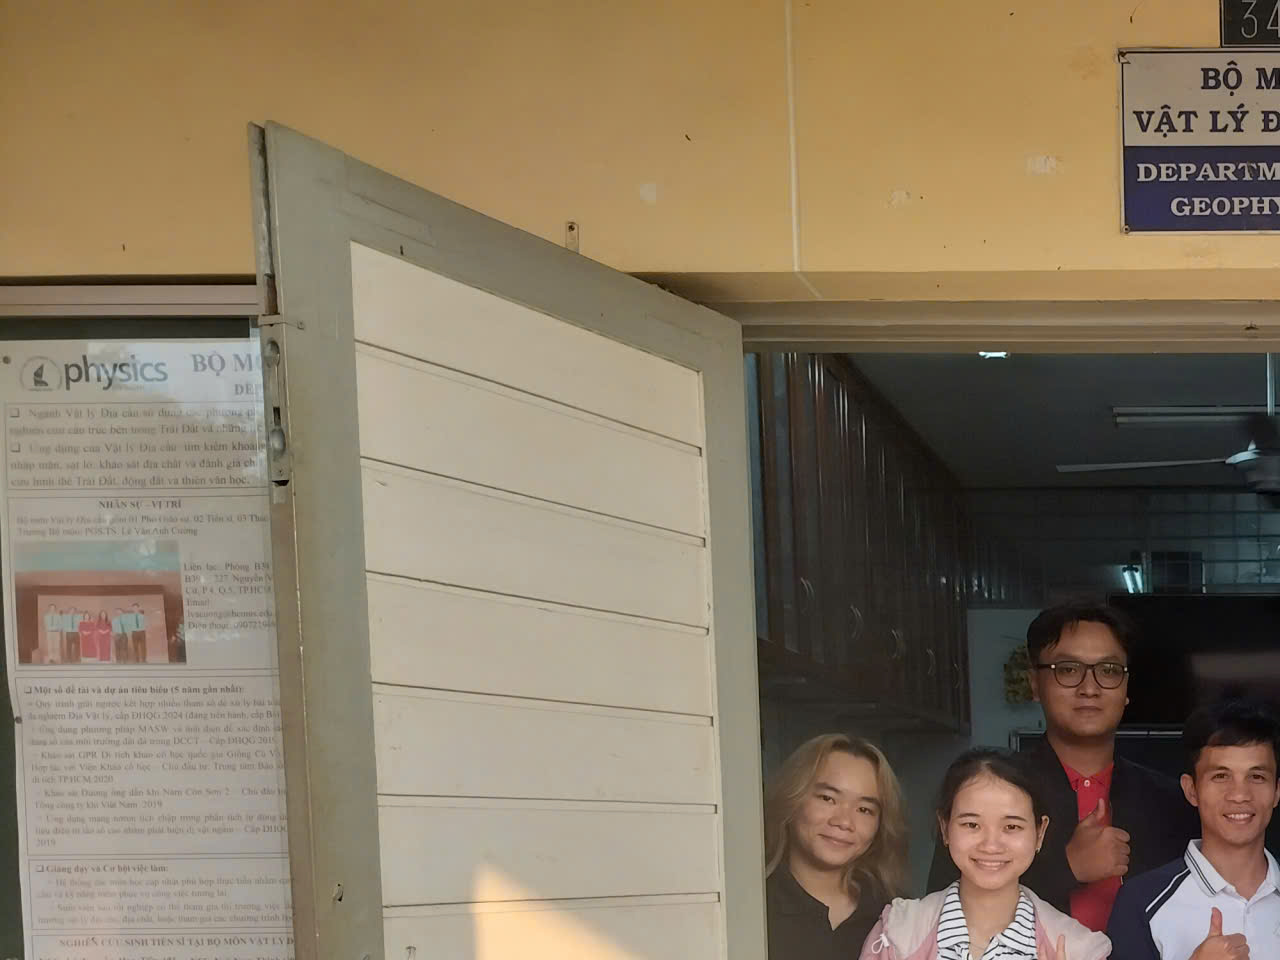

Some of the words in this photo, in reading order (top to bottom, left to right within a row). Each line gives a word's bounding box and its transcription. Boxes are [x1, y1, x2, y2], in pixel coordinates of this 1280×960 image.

[1200, 60, 1243, 96] BỘ
[1133, 105, 1198, 138] VẬT
[1209, 103, 1249, 133] LÝ
[64, 355, 169, 391] physics
[192, 351, 226, 377] BỘ
[233, 353, 262, 372] M
